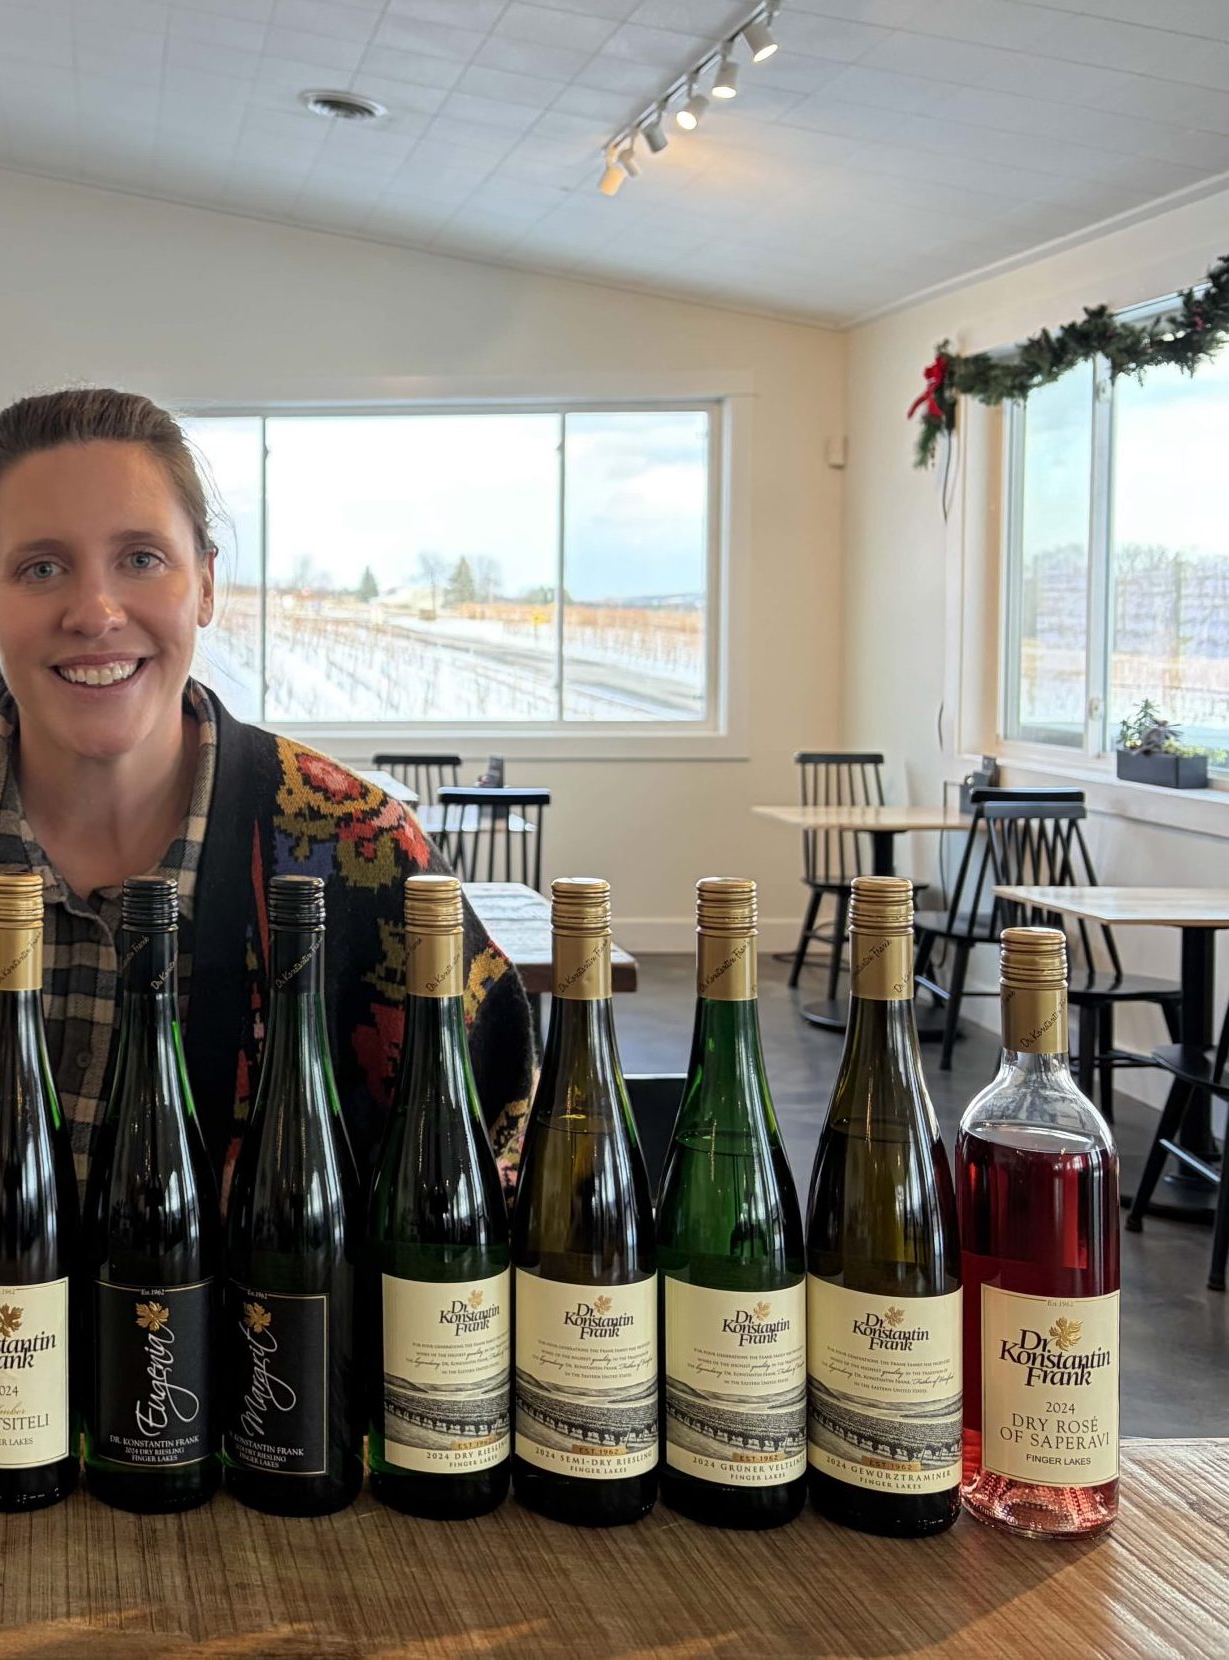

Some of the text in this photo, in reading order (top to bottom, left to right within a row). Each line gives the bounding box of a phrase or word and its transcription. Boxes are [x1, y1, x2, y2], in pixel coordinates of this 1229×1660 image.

[438, 1304, 500, 1324] Konstantin
[451, 1300, 468, 1314] Dr.
[576, 1302, 595, 1317] Dr.
[563, 1311, 634, 1328] Konstantin
[735, 1310, 754, 1324] Dr.
[865, 1312, 886, 1329] Dr.
[454, 1318, 490, 1337] Frank
[579, 1324, 620, 1340] Frank
[721, 1318, 790, 1334] Konstantin
[852, 1320, 930, 1341] Konstantin
[738, 1332, 778, 1347] Frank
[868, 1337, 913, 1351] Frank
[1020, 1328, 1051, 1353] Dr.
[998, 1339, 1111, 1370] Konstantin
[135, 1322, 199, 1437] Eugenia
[239, 1321, 297, 1436] Margrit
[1024, 1364, 1092, 1387] Frank
[1046, 1401, 1076, 1415] 2024
[1011, 1413, 1099, 1434] DRY ROSÉ
[9, 1437, 34, 1446] LAKES
[110, 1434, 200, 1448] DR. KONSTANTIN FRANK
[1000, 1426, 1110, 1450] OF SAPERAVI
[131, 1454, 156, 1462] FINGER
[154, 1447, 185, 1455] RIESLING
[257, 1451, 287, 1462] RIESLING
[277, 1446, 304, 1456] FRANK
[426, 1452, 449, 1460] 2024
[454, 1452, 473, 1460] DRY
[535, 1447, 652, 1466] 2024 SEMI-DRY RIESLING
[449, 1454, 498, 1468] FINGER LAKES
[692, 1457, 715, 1468] 2024
[720, 1462, 765, 1473] GRÜNER
[891, 1463, 913, 1471] 1962
[1026, 1453, 1091, 1466] FINGER LAKES
[570, 1465, 601, 1474] FINGER
[826, 1456, 951, 1482] 2024 GEWÜRZTRAMINER
[730, 1473, 786, 1481] FINGER LAKES
[859, 1476, 921, 1489] FINGER LAKES
